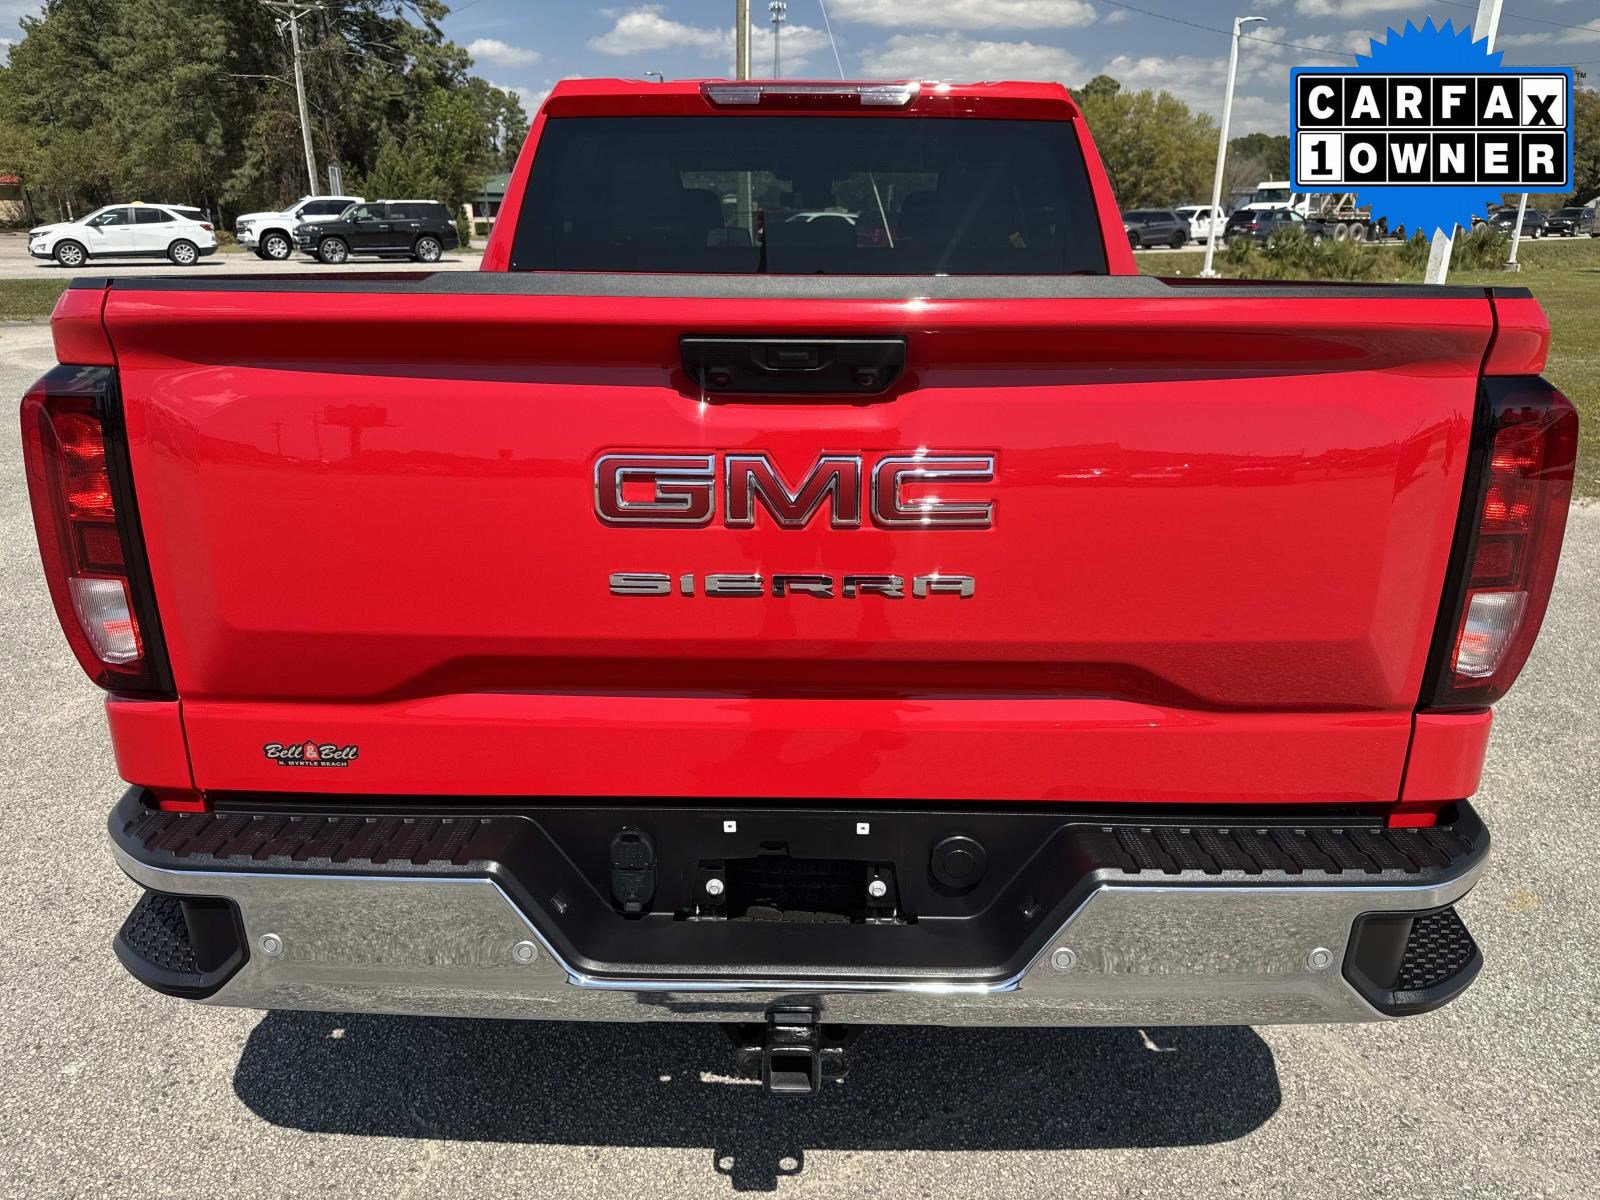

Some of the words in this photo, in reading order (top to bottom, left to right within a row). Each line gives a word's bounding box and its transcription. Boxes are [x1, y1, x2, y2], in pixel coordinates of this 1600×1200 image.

[594, 451, 995, 527] GMC
[608, 572, 976, 599] SIERRA
[265, 744, 303, 759] Bell
[306, 745, 318, 758] &
[319, 745, 358, 760] Bell
